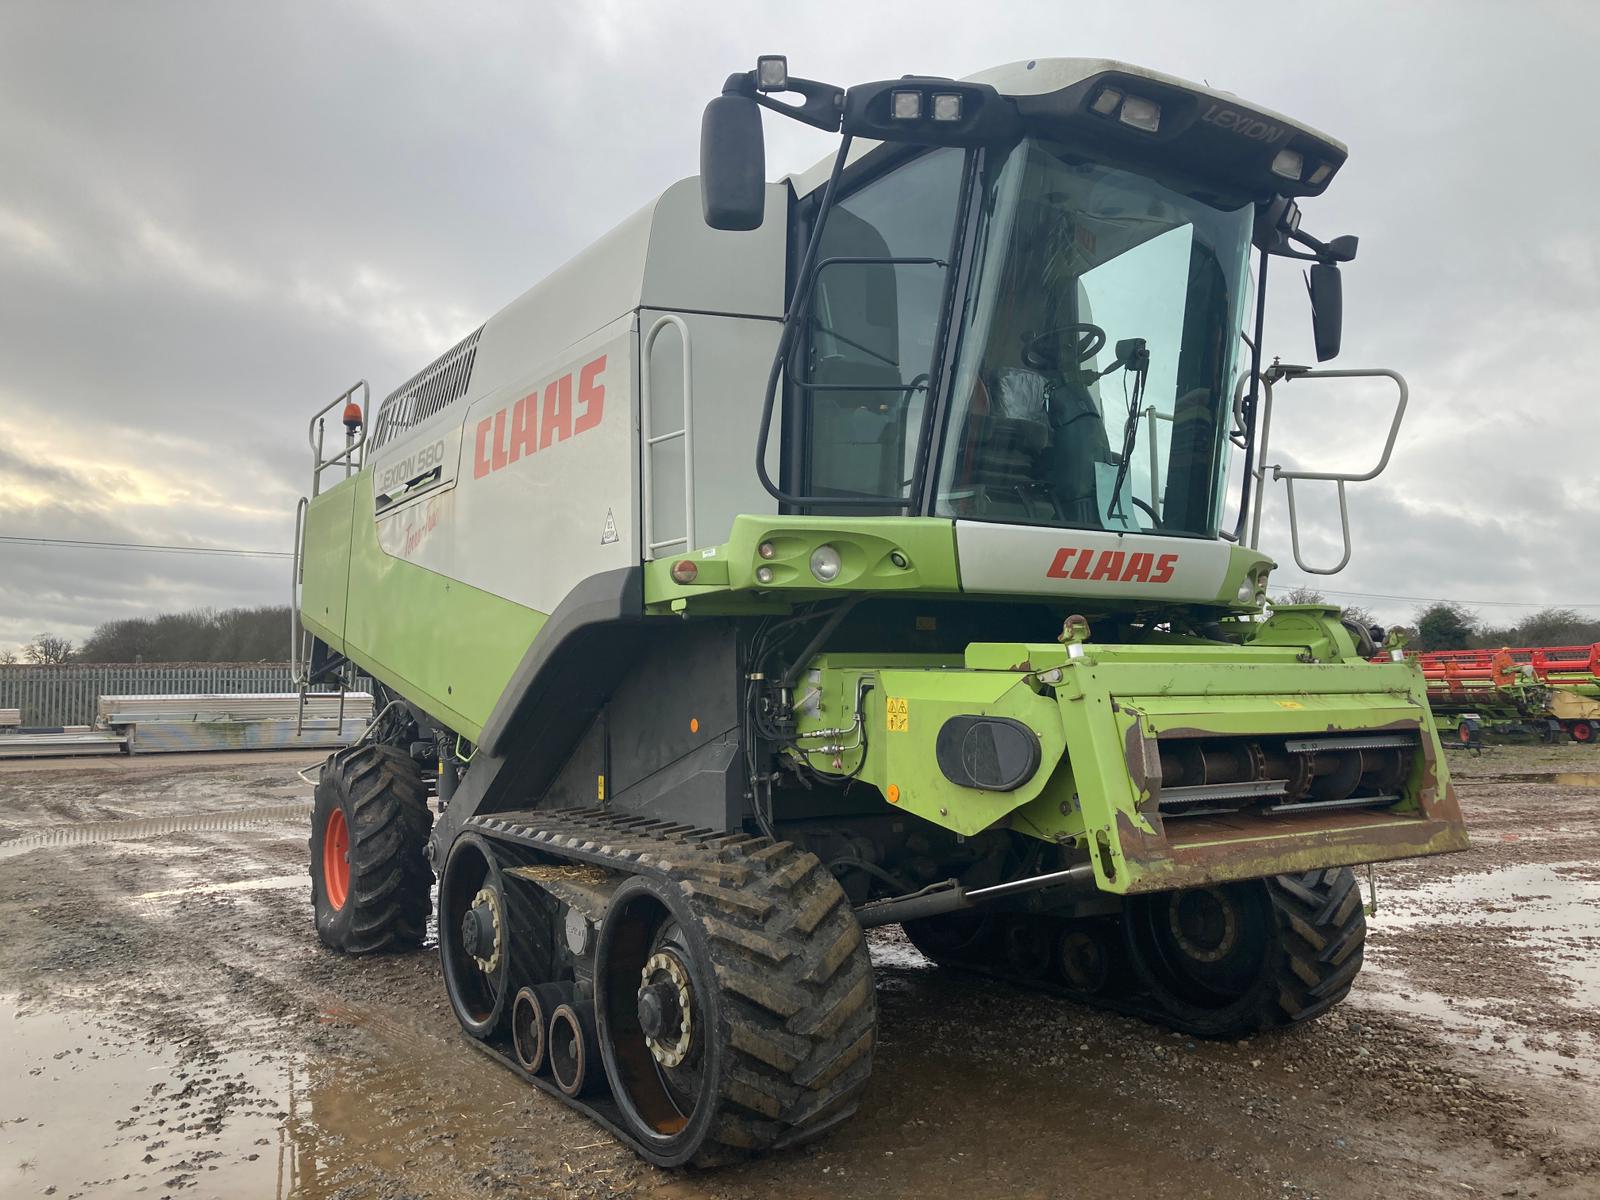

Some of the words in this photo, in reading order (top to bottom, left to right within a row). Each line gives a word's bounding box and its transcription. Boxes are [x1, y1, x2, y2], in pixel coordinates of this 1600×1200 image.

[1202, 105, 1284, 144] LEXION
[474, 354, 607, 480] CLAAS
[417, 440, 443, 472] 580
[1046, 547, 1178, 583] CLAAS
